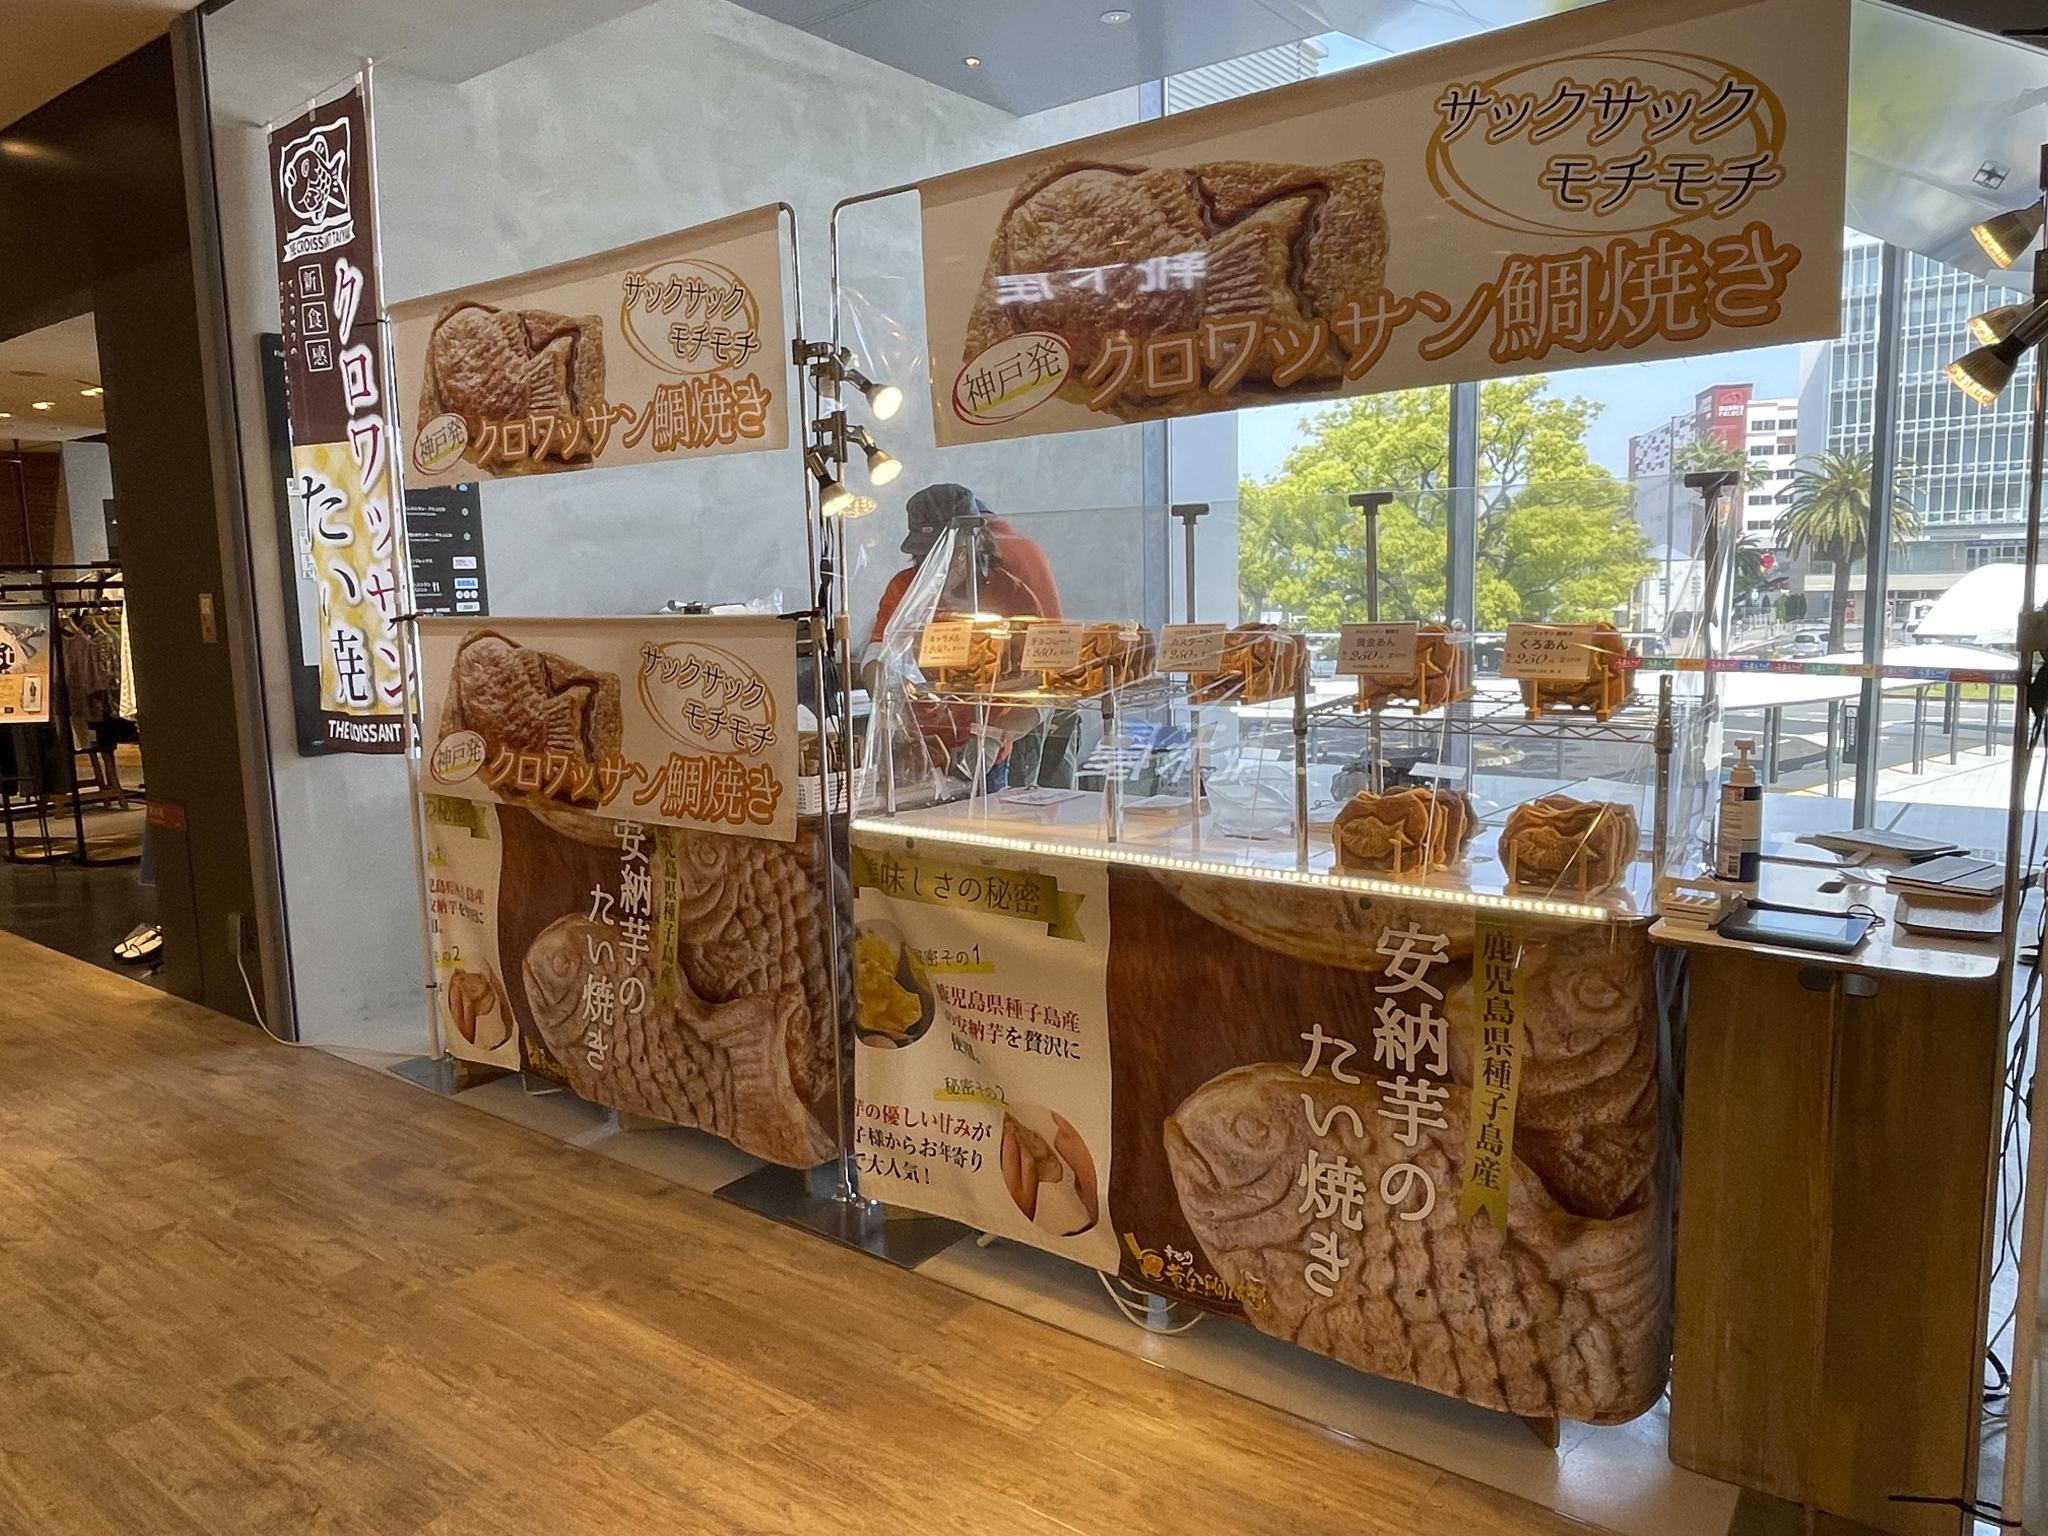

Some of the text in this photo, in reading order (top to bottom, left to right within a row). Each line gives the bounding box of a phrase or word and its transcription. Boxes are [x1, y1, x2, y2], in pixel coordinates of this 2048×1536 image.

[1439, 78, 1759, 144] サックサック
[1544, 149, 1785, 215] モチモチ
[624, 271, 745, 319] サックサック
[1084, 221, 1800, 404] クロワッサン鯛焼き
[670, 322, 759, 368] モチモチ
[961, 341, 1064, 412] 神戸発
[419, 420, 465, 460] 神戸発
[473, 373, 771, 462] クロワッサン鯛焼き
[641, 644, 767, 708] サックサック
[1520, 639, 1569, 650] くろあん
[437, 736, 483, 771] 神戸発
[684, 700, 777, 755] モチモチ
[488, 751, 783, 825] クロワッサン鯛焼き
[613, 822, 653, 1014] 安納芋の
[582, 883, 615, 1071] たい焼き
[1373, 922, 1449, 1221] 安納芋の
[1469, 927, 1516, 1193] 鹿児島県種子島産
[1297, 1023, 1367, 1297] たい焼き
